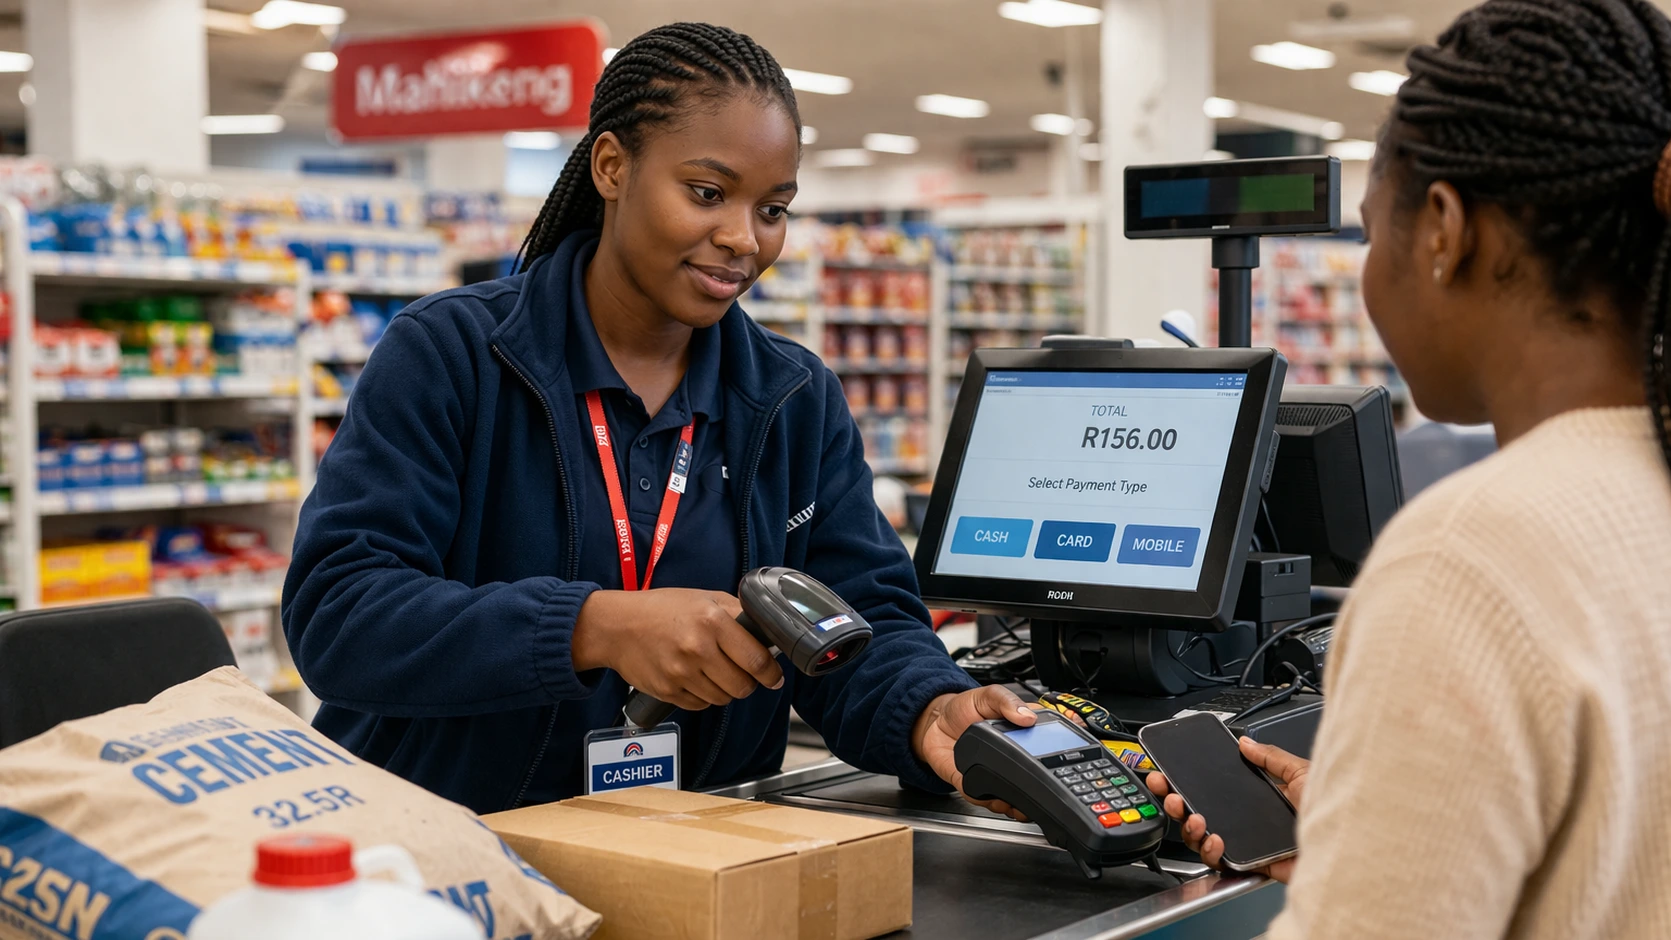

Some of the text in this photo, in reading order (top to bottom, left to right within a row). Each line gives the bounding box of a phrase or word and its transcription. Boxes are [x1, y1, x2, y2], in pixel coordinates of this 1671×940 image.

[1090, 404, 1128, 417] TOTAL
[1080, 426, 1178, 451] R156.00
[1028, 476, 1148, 494] Select Payment Type
[974, 529, 1009, 543] CASH
[1056, 533, 1093, 548] CARD
[1132, 537, 1185, 553] MOBILE
[131, 729, 357, 805] CEMENT
[602, 764, 663, 784] CASHIER
[252, 785, 366, 828] 32.5R
